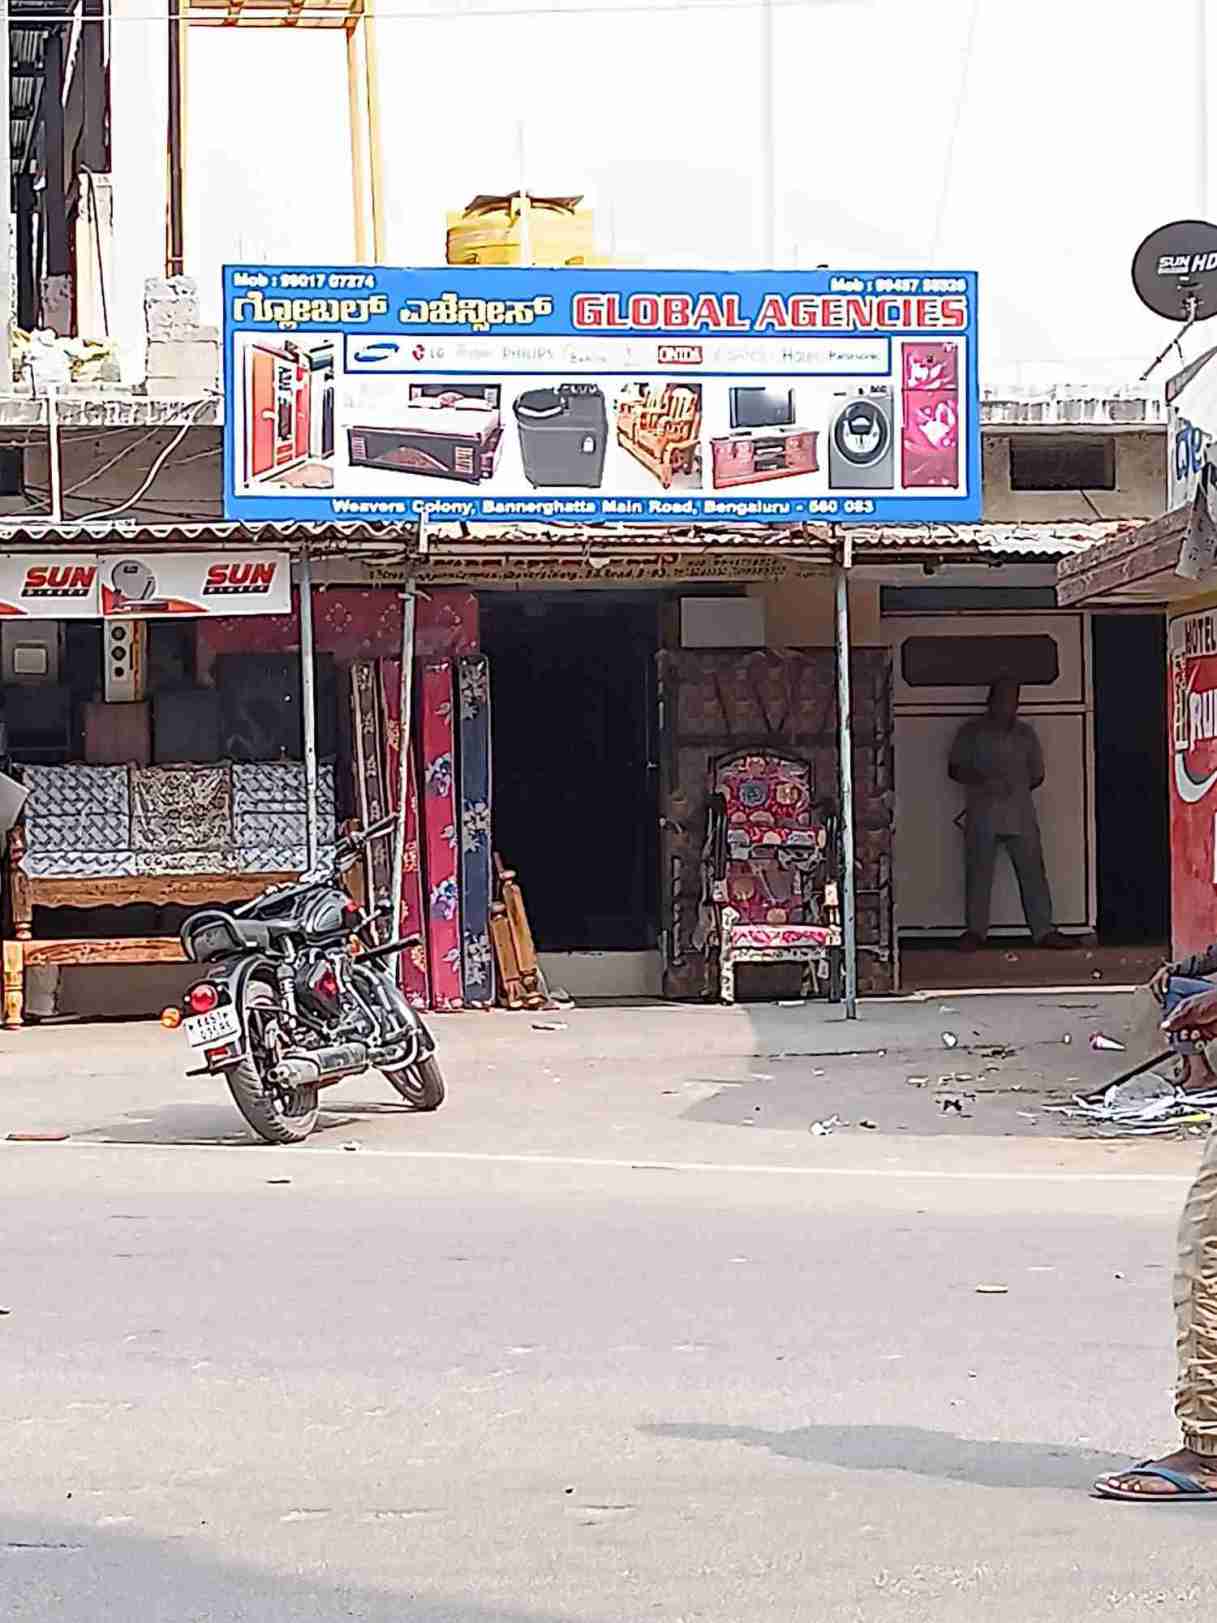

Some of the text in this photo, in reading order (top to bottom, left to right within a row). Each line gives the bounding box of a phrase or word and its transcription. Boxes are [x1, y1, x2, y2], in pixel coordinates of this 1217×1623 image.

[233, 272, 269, 287] Mob
[574, 295, 967, 331] GLOBAL AGENCIES
[332, 499, 405, 513] Weavers
[602, 500, 642, 513] Main
[649, 500, 697, 515] Road,
[704, 500, 790, 515] Bengaluru
[25, 566, 97, 588] SUN
[206, 562, 277, 585] SUN
